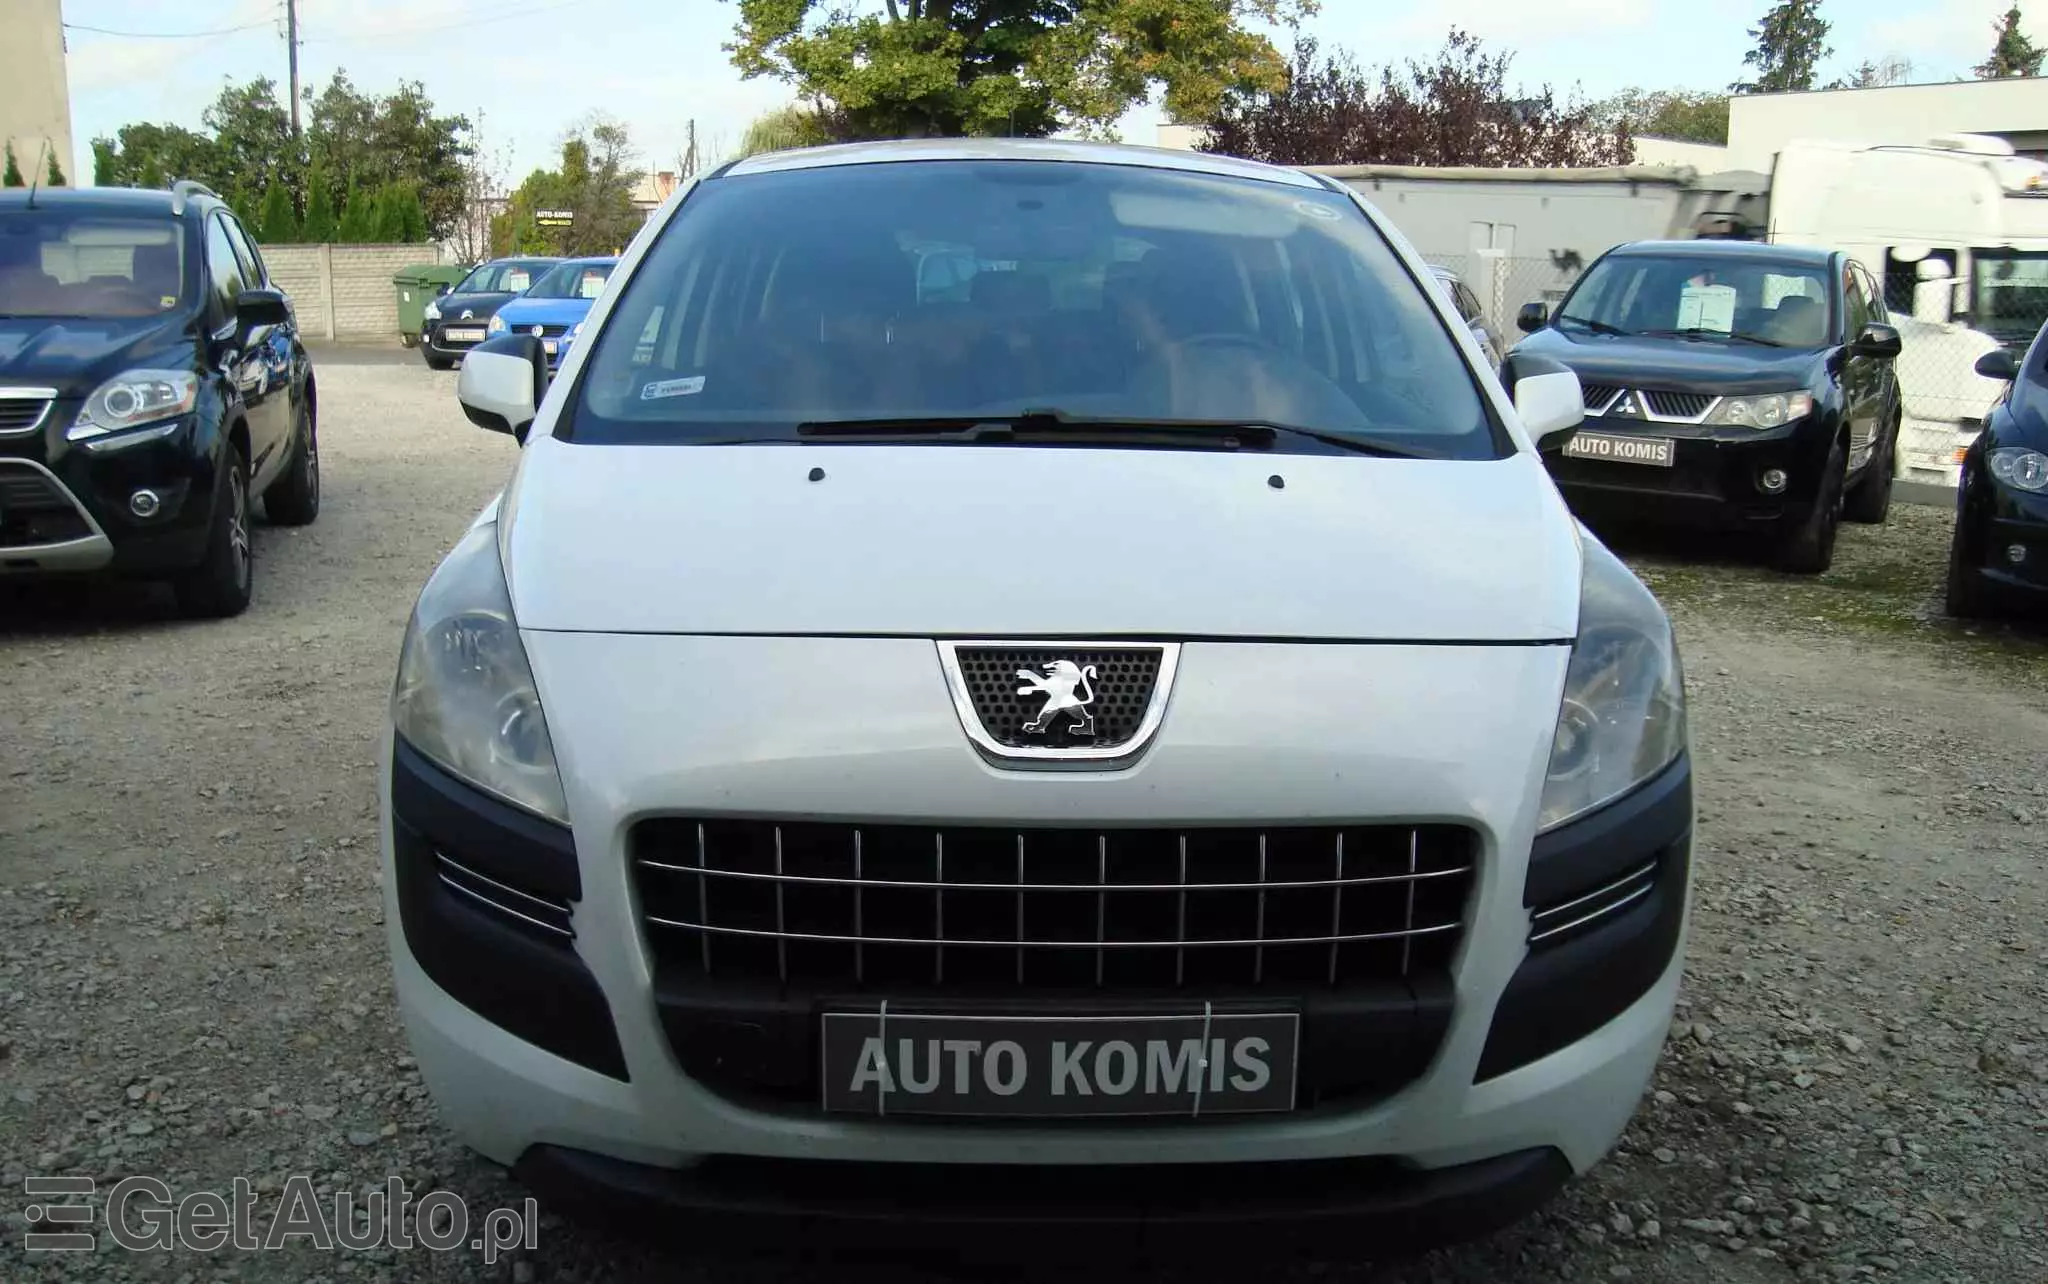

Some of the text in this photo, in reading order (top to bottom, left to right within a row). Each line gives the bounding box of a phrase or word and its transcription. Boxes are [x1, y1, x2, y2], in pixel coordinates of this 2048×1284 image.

[1569, 436, 1668, 460] AUTO KOMIS
[849, 1036, 1271, 1096] AUTO KOMIS
